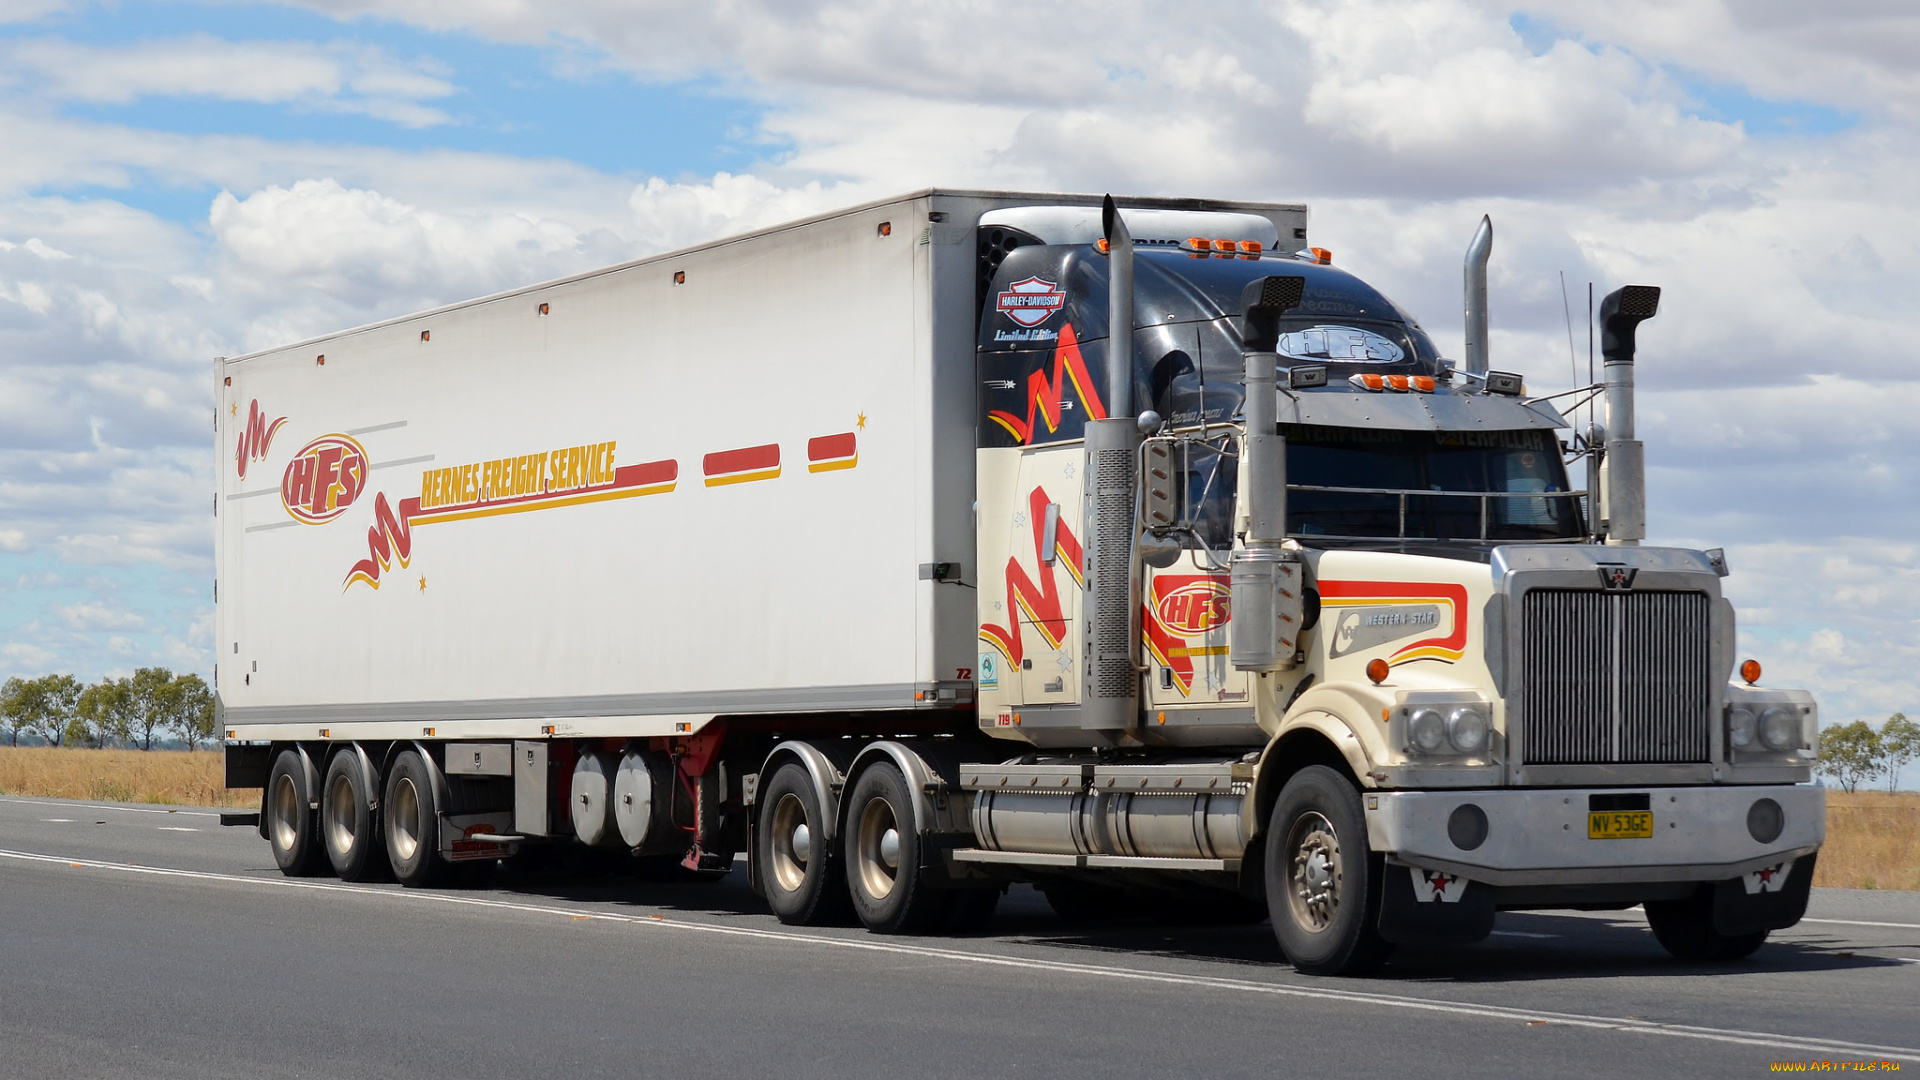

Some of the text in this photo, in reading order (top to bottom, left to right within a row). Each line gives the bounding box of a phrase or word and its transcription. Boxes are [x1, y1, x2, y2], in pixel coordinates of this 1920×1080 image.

[1001, 295, 1061, 307] HARLEY-DAVIDSON
[994, 329, 1031, 341] Limited
[1286, 328, 1398, 362] HFS
[288, 445, 359, 516] HFS
[421, 440, 617, 508] HERNES FREIGHT SERVICE
[1165, 592, 1231, 630] HFS
[1365, 611, 1435, 627] WESTERN STAR
[956, 668, 972, 680] 72
[998, 714, 1011, 726] 119
[1592, 814, 1649, 832] NV 53GE
